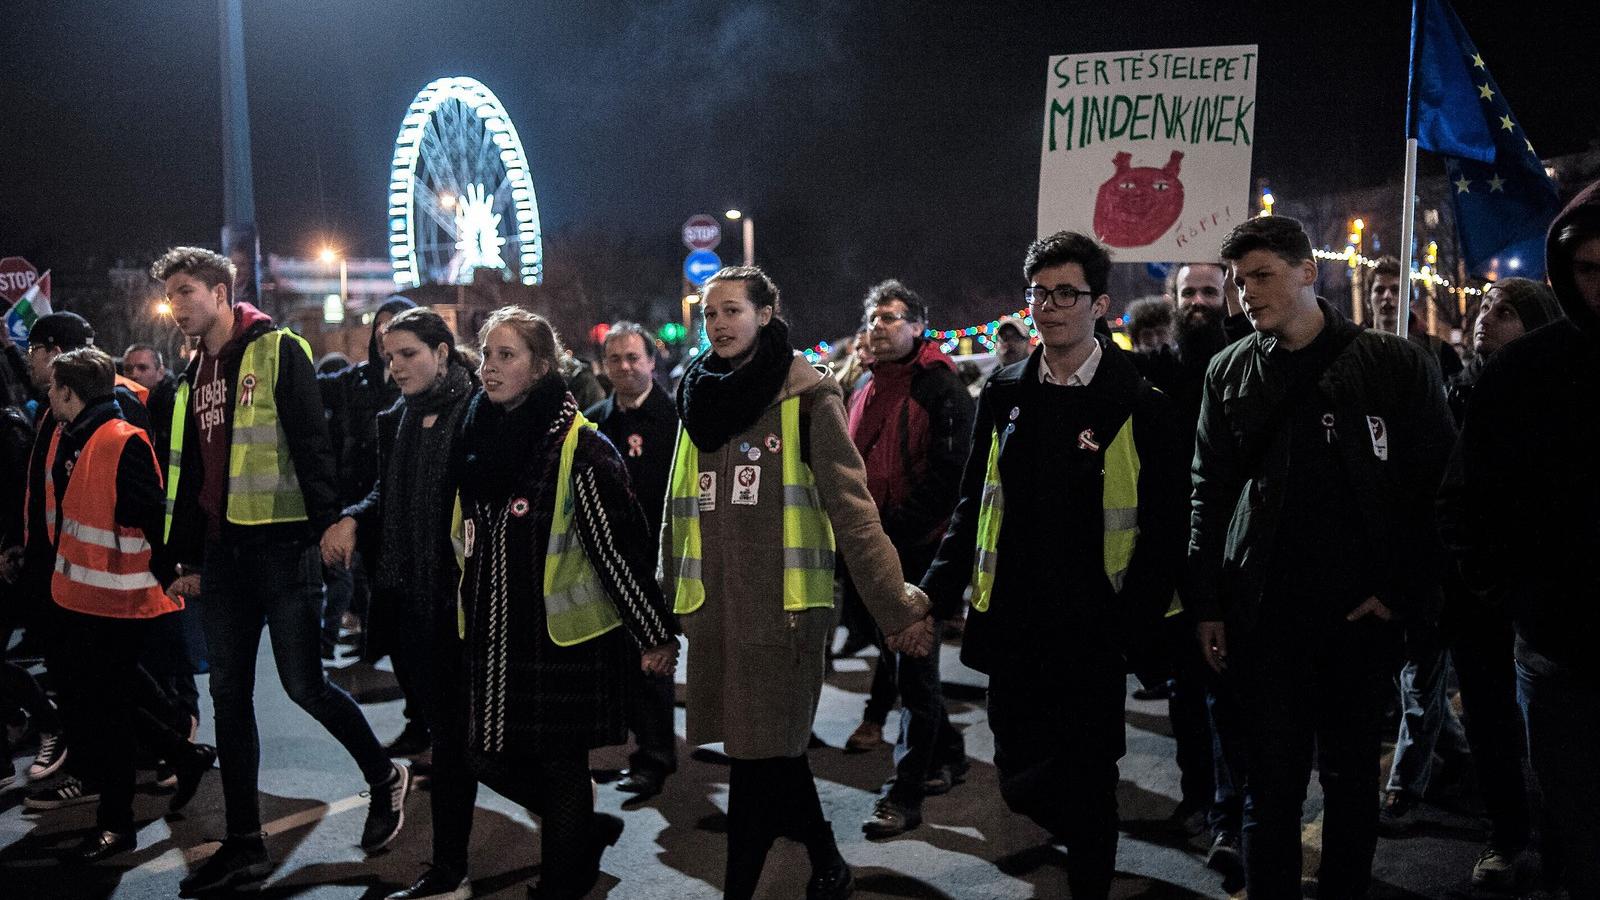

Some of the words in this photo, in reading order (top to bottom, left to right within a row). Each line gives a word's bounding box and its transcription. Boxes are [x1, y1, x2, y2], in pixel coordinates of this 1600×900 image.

[1054, 52, 1256, 88] SERTÉSTELEPET
[1049, 93, 1255, 151] MINDENKINEK
[0, 270, 36, 291] STOP
[200, 407, 225, 430] 1991
